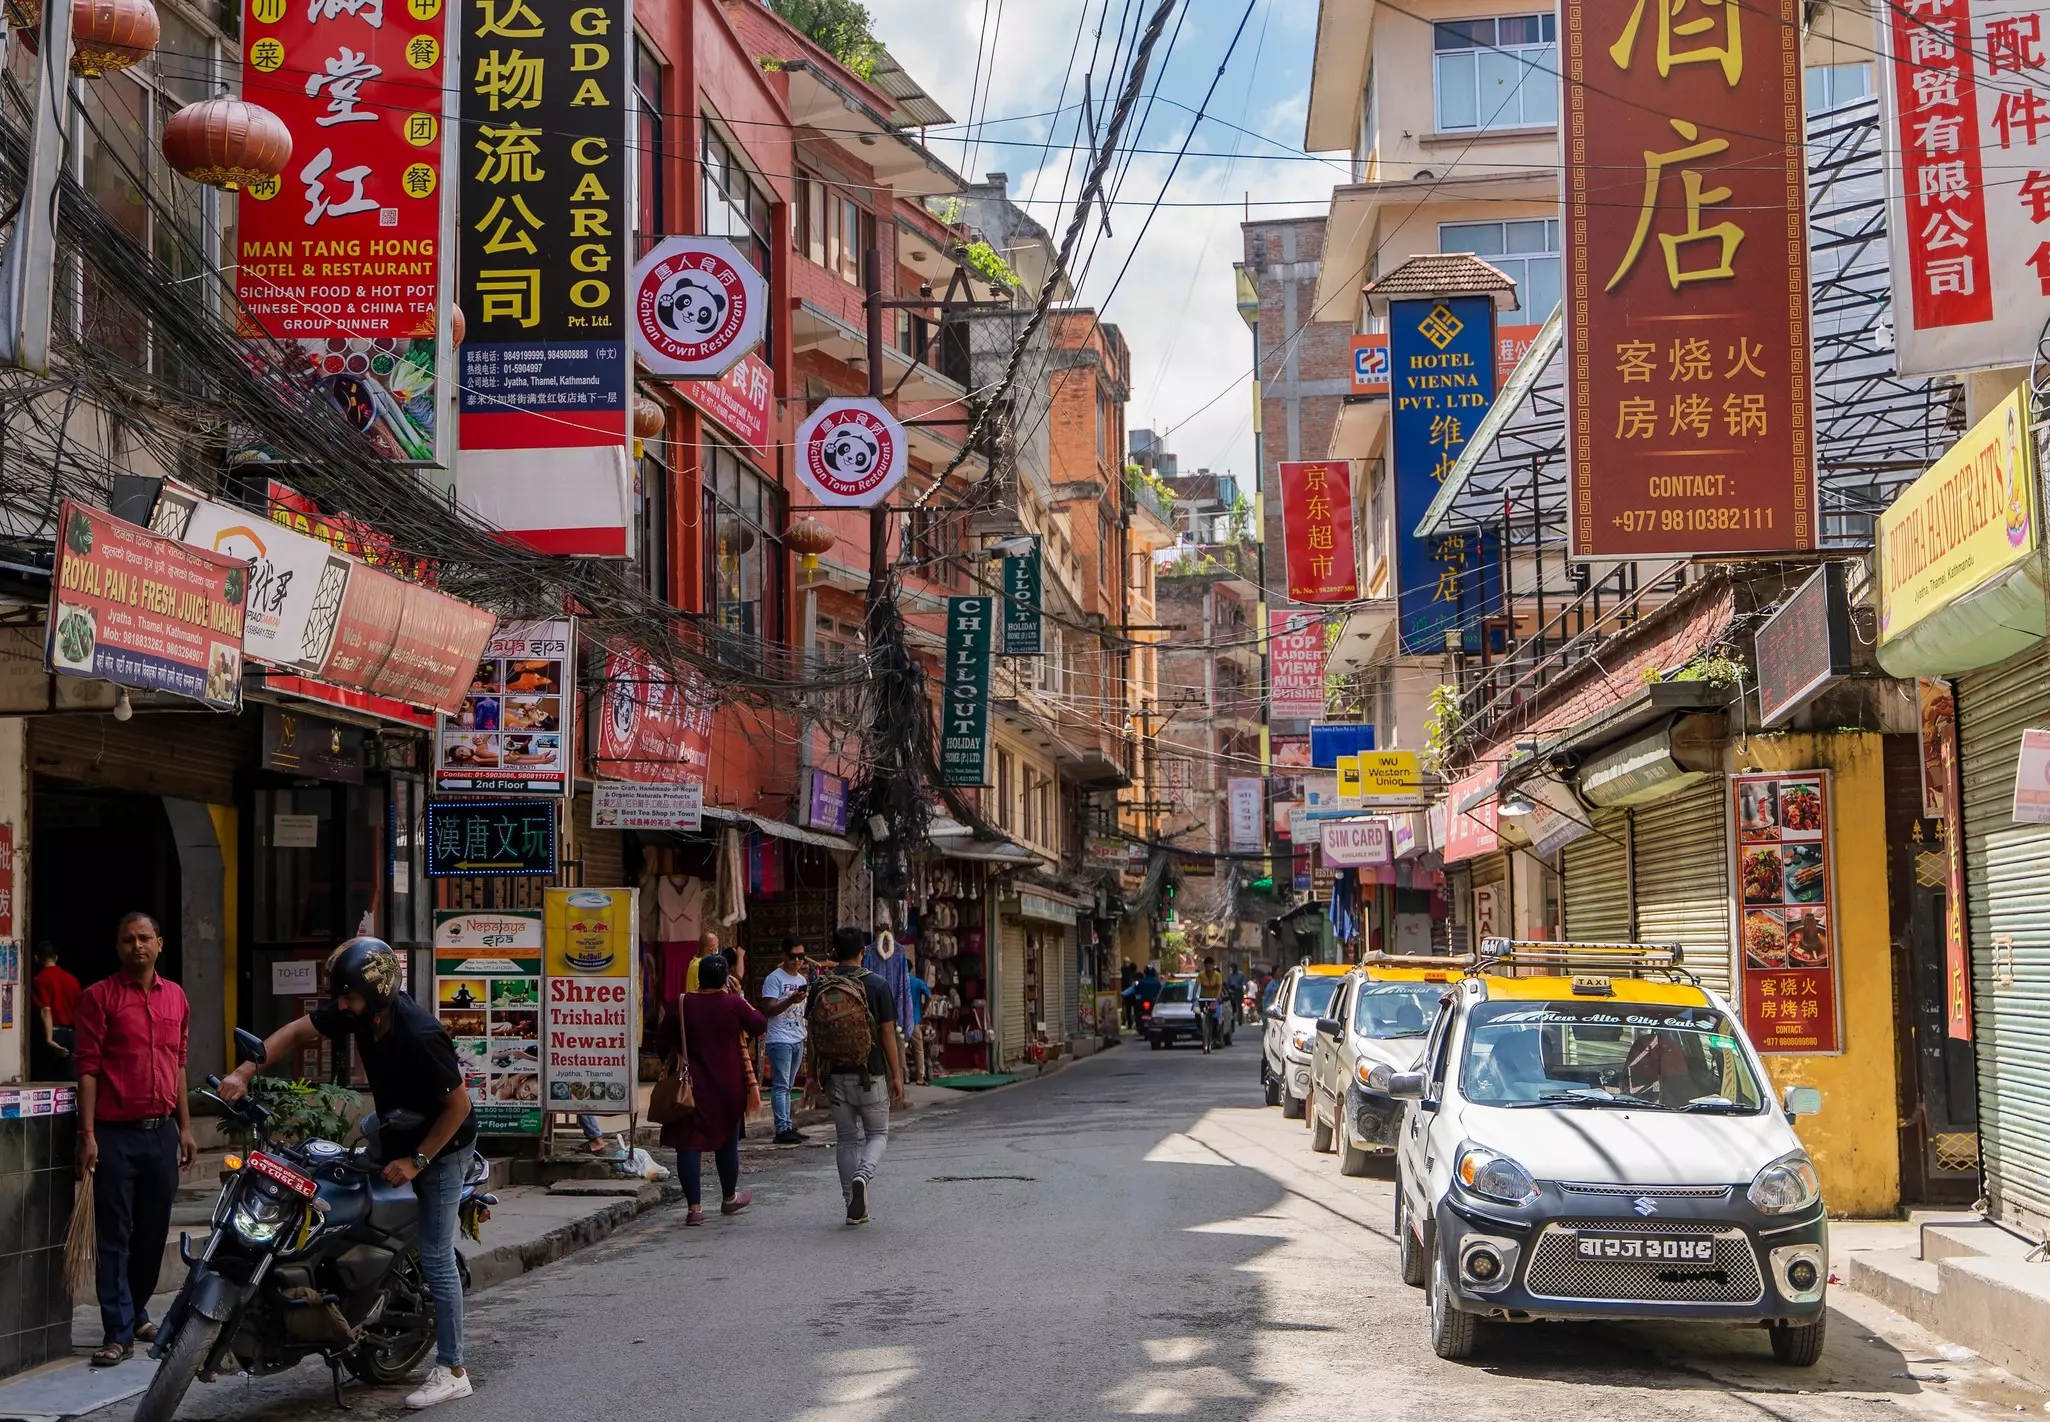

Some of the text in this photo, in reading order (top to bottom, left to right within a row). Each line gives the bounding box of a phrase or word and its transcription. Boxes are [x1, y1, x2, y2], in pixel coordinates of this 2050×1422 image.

[1604, 0, 1746, 294] 酒店
[569, 137, 612, 309] CARGO
[243, 239, 434, 257] MAN TANG HONG
[243, 262, 433, 277] HOTEL & RESTAURANT
[240, 285, 435, 298] SICHUAN FOOD & HOT POT
[239, 302, 435, 315] CHINESE FOOD & CHINA TEA
[283, 318, 389, 330] GROUP DINNER
[568, 315, 613, 328] Pvt. Ltd.
[640, 289, 743, 357] Sichuan Town Restaurant
[1410, 352, 1475, 370] HOTEL
[503, 364, 543, 375] 01-5904997
[504, 375, 600, 389] Jyatha, Thamel, Kathmandu
[1407, 373, 1479, 390] VIENNA
[1398, 392, 1490, 411] PVT. LTD.
[810, 440, 891, 492] Sichuan Town Restaurant
[1611, 507, 1774, 532] +977 9810382111
[1889, 436, 2005, 593] BUDDHA HANDICRAFTS
[1304, 464, 1335, 581] 京东超市
[1947, 554, 1975, 581] Kathmandu
[61, 555, 101, 598] ROYAL
[103, 567, 128, 606] PAN
[129, 576, 138, 608] &
[140, 578, 178, 620] FRESH
[210, 600, 243, 640] MAHAL
[103, 625, 121, 643] Mob:
[138, 616, 204, 646] Thamel, Kathmandu
[1007, 623, 1038, 631] HOLIDAY
[342, 626, 362, 648] Web
[1279, 635, 1317, 649] TOP
[1273, 650, 1322, 660] LADDER
[953, 599, 982, 735] CHILLOUT
[1277, 662, 1318, 674] VIEW
[1274, 675, 1322, 687] MULTI
[1273, 688, 1324, 699] CUISINE
[946, 737, 982, 751] HOLIDAY
[1381, 758, 1399, 767] WU
[443, 771, 474, 779] Contact:
[1368, 768, 1411, 777] Western
[476, 780, 525, 790] 2nd Floor
[1375, 777, 1404, 787] Union
[651, 810, 669, 818] Shop
[1328, 828, 1383, 848] SIM CARD
[466, 919, 527, 934] Nepalaya
[278, 968, 310, 978] TO-LET
[1578, 978, 1608, 987] TAXI
[551, 979, 626, 1003] Shree
[551, 1008, 626, 1026] Trishakti
[1581, 1013, 1621, 1023] Alto
[1626, 1015, 1660, 1027] City
[1775, 1025, 1804, 1034] CONTACT:
[551, 1031, 626, 1050] Newari
[1763, 1037, 1778, 1046] +977
[550, 1052, 626, 1067] Restaurant
[556, 1070, 583, 1078] Jyatha,
